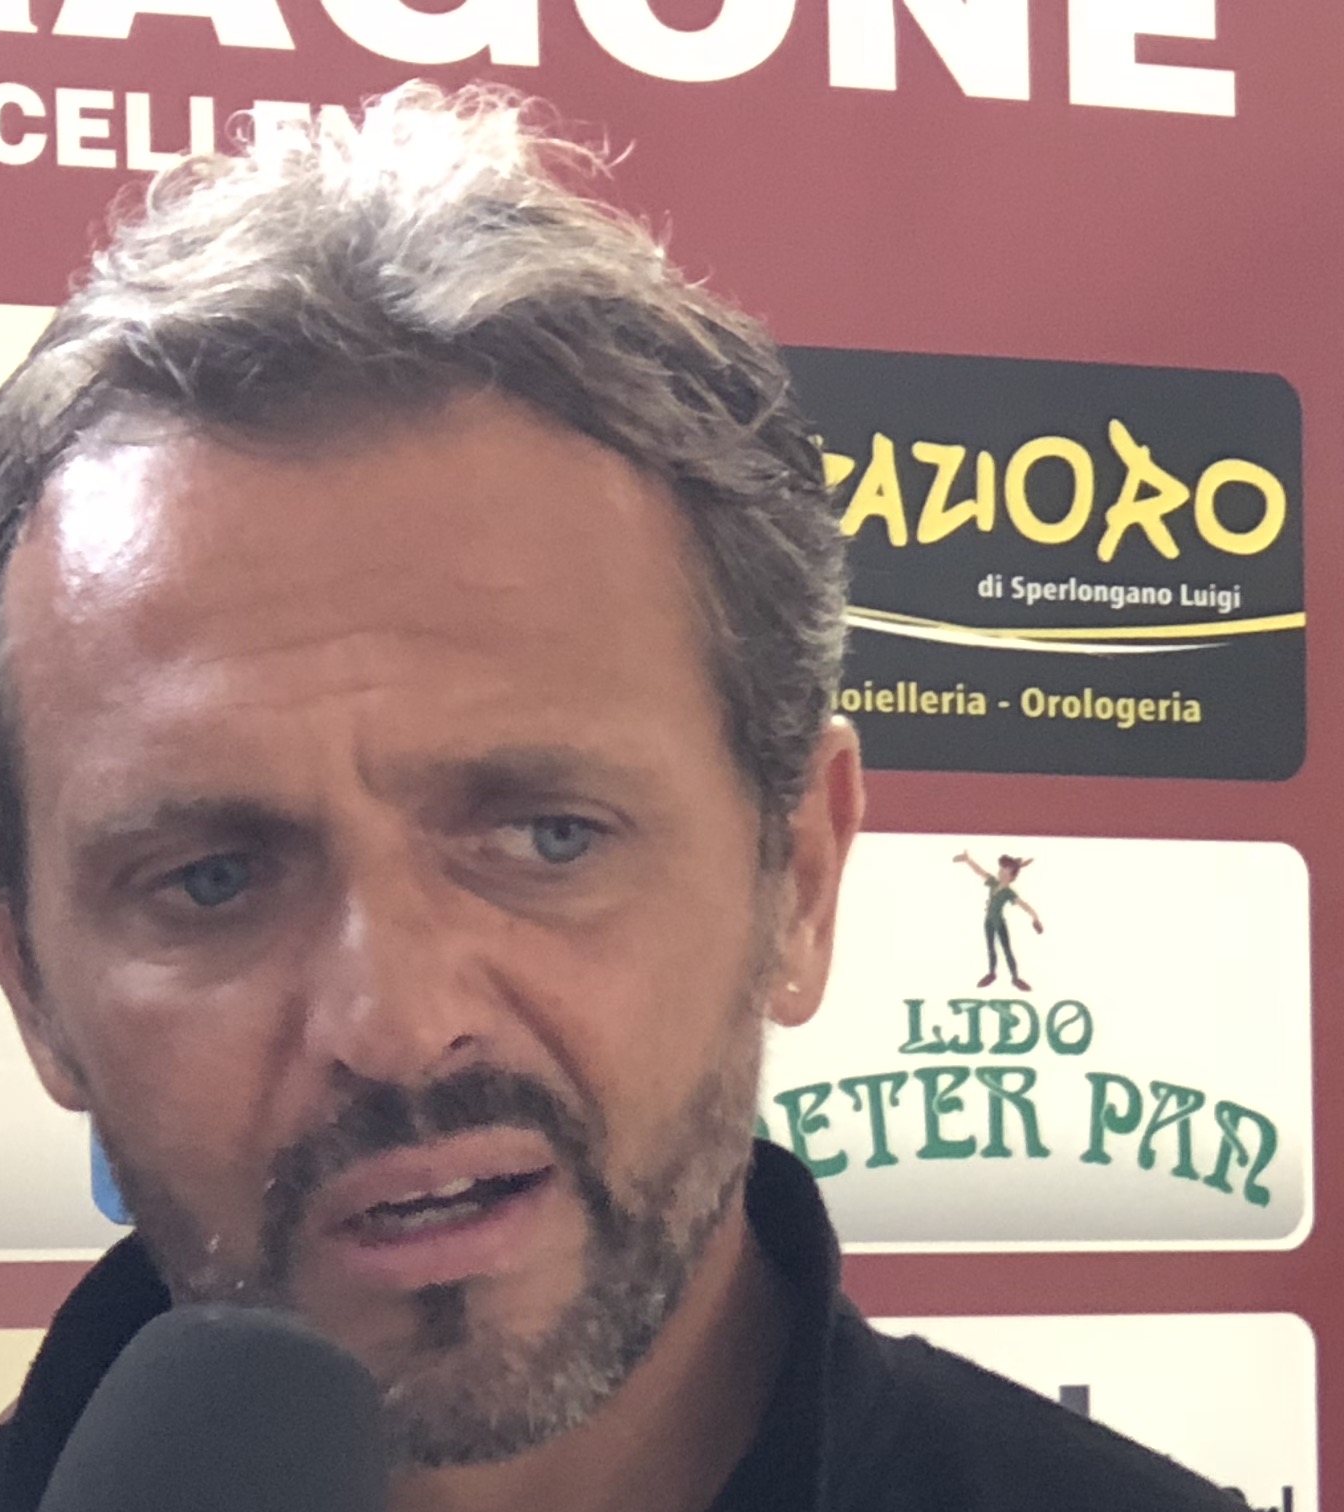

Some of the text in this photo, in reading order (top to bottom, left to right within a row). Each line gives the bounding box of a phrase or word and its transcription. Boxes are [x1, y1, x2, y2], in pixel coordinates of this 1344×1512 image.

[977, 575, 1241, 613] di Sperlongano Luigi
[1021, 688, 1201, 728] Orologeria
[757, 1066, 1052, 1180] ETER
